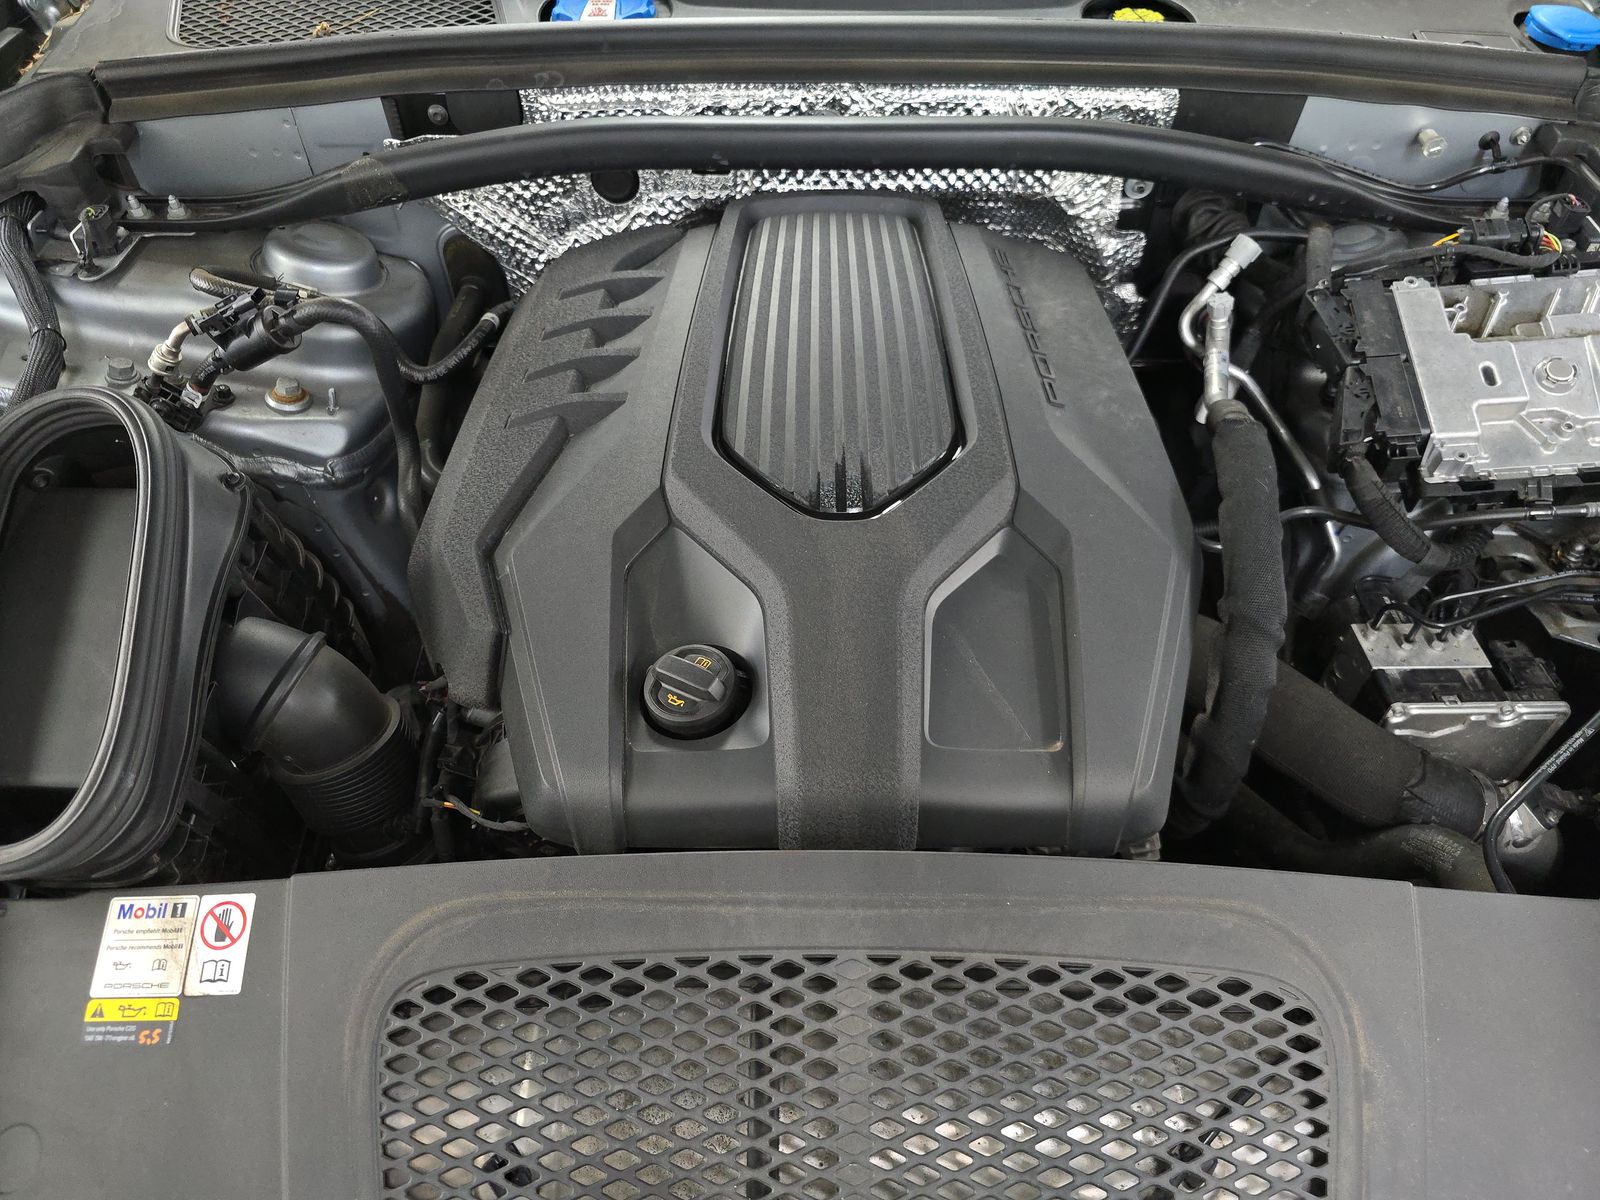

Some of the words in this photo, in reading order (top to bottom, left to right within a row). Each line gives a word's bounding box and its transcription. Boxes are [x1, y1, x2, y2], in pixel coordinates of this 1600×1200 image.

[993, 248, 1066, 409] PORSCHE
[117, 903, 168, 920] Mobil
[171, 902, 188, 918] 1
[104, 982, 170, 990] PORSCHE
